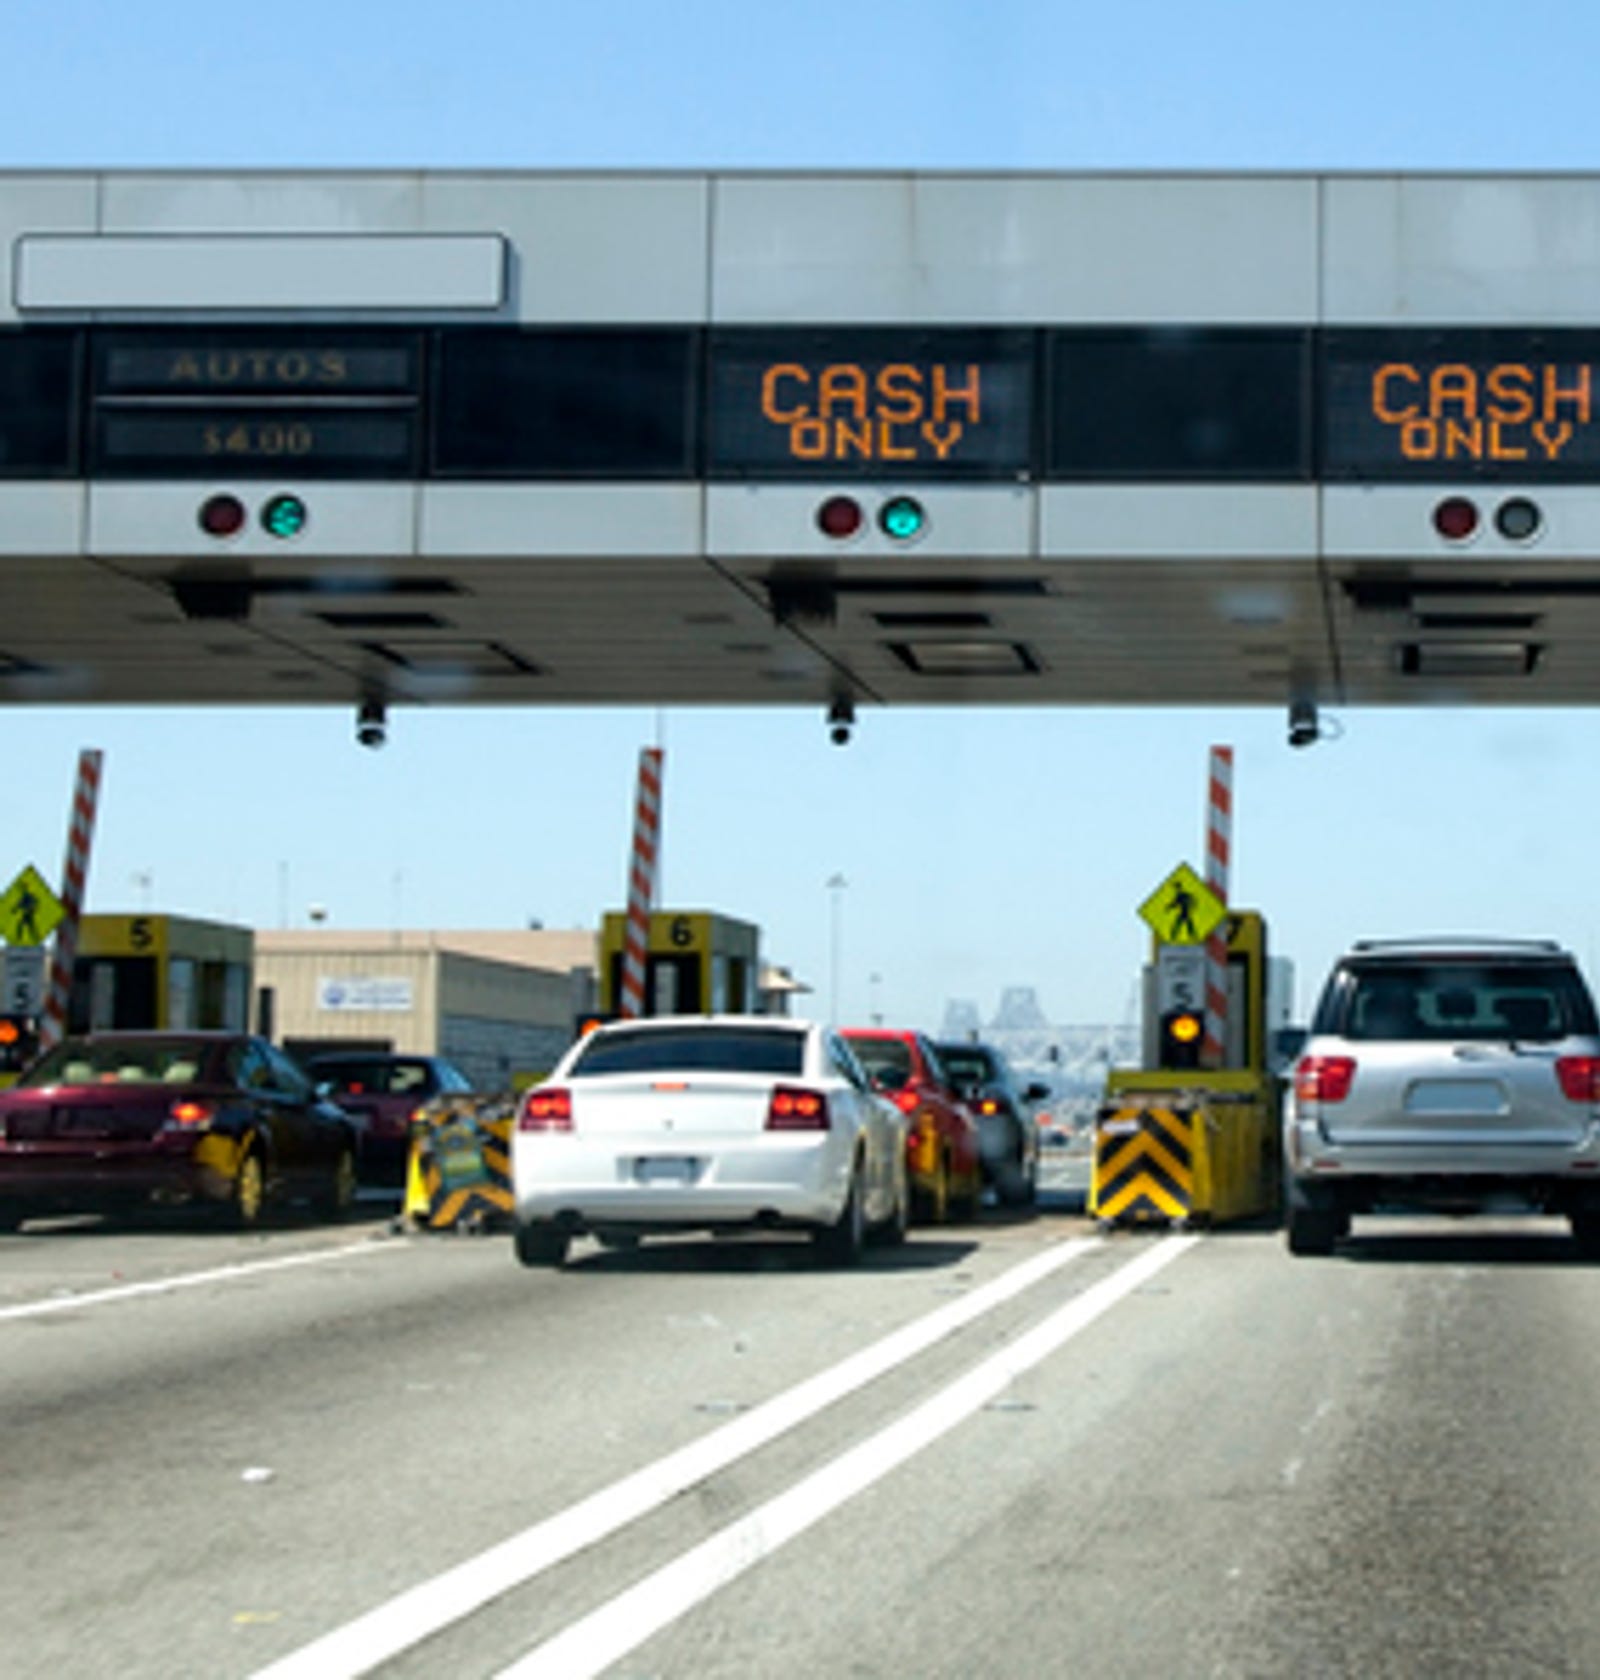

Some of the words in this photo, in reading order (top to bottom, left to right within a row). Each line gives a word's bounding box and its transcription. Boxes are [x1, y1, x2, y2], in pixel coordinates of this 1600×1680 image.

[170, 351, 347, 384] AUTOS
[762, 363, 979, 423] CASH
[1372, 363, 1589, 423] CASH
[790, 417, 962, 459] ONLY
[1400, 417, 1572, 459] ONLY
[131, 918, 153, 949] 5
[671, 915, 693, 946] 6
